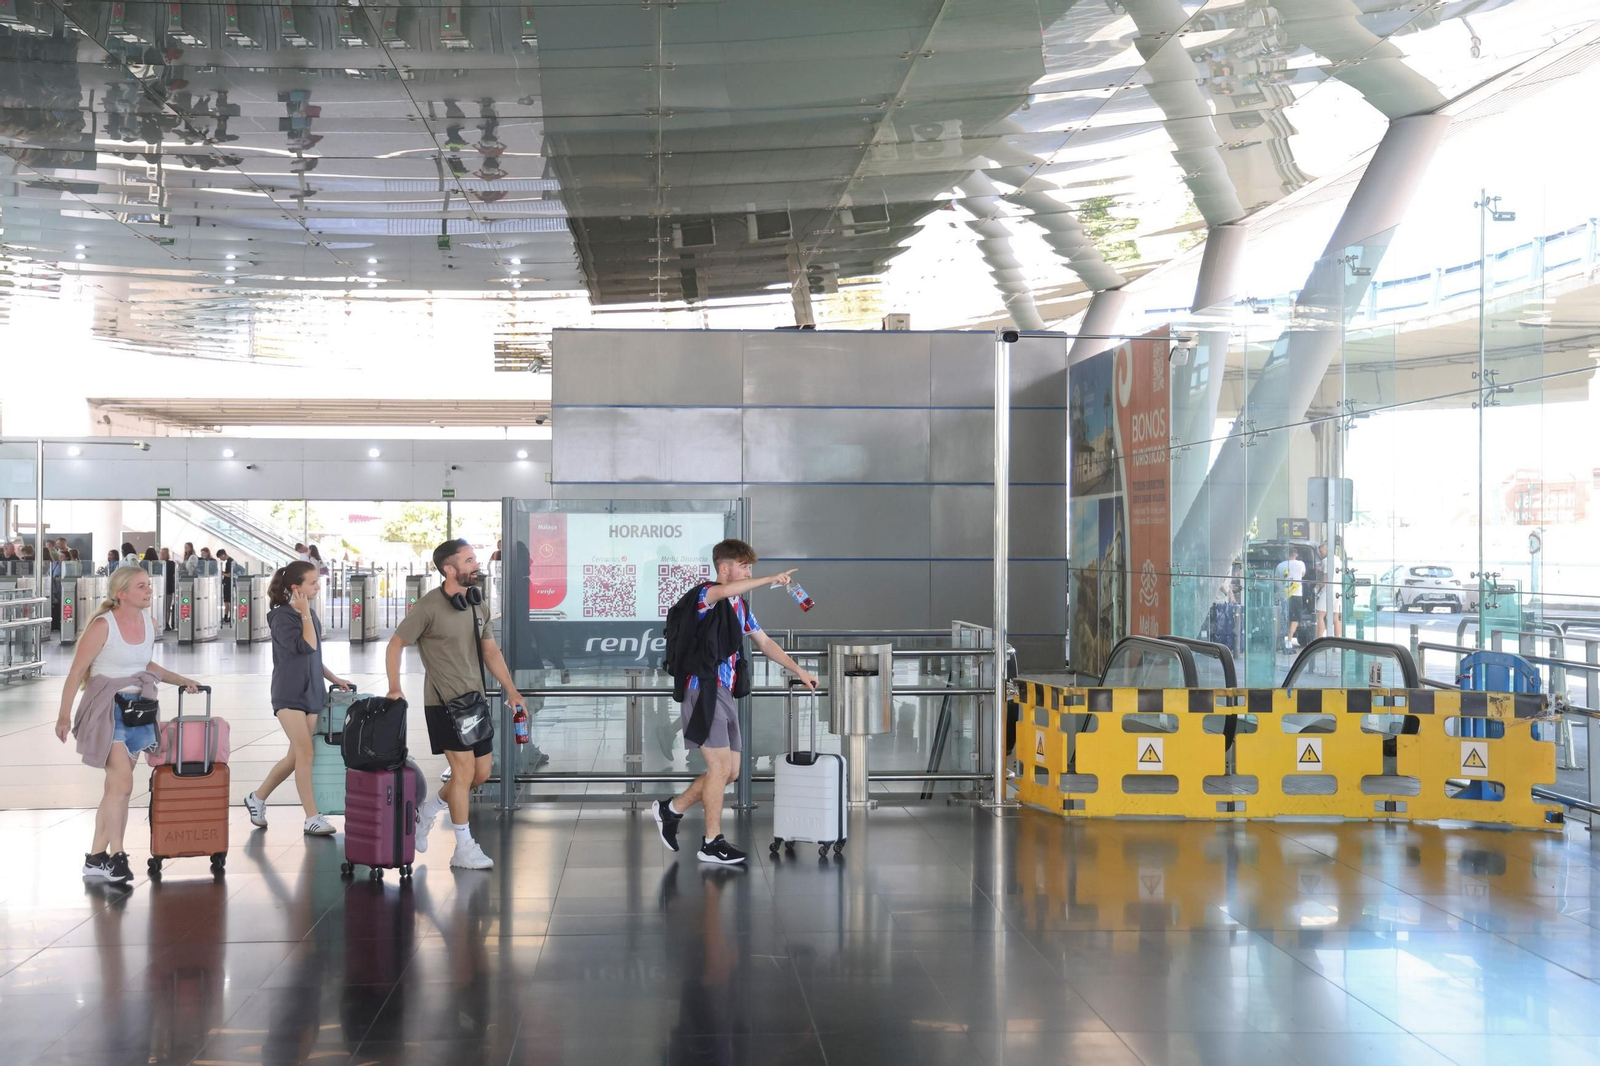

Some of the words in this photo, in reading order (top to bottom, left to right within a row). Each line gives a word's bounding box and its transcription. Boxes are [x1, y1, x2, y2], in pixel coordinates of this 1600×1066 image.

[1132, 407, 1166, 443] BONOS
[537, 523, 558, 531] Málaga
[608, 524, 683, 538] HORARIOS
[660, 555, 679, 563] Media
[680, 555, 708, 563] Distancia
[537, 588, 556, 596] renfe
[1139, 614, 1159, 637] Melilla
[585, 628, 667, 661] renfe
[317, 791, 345, 802] ANT
[164, 828, 220, 842] ANTLER
